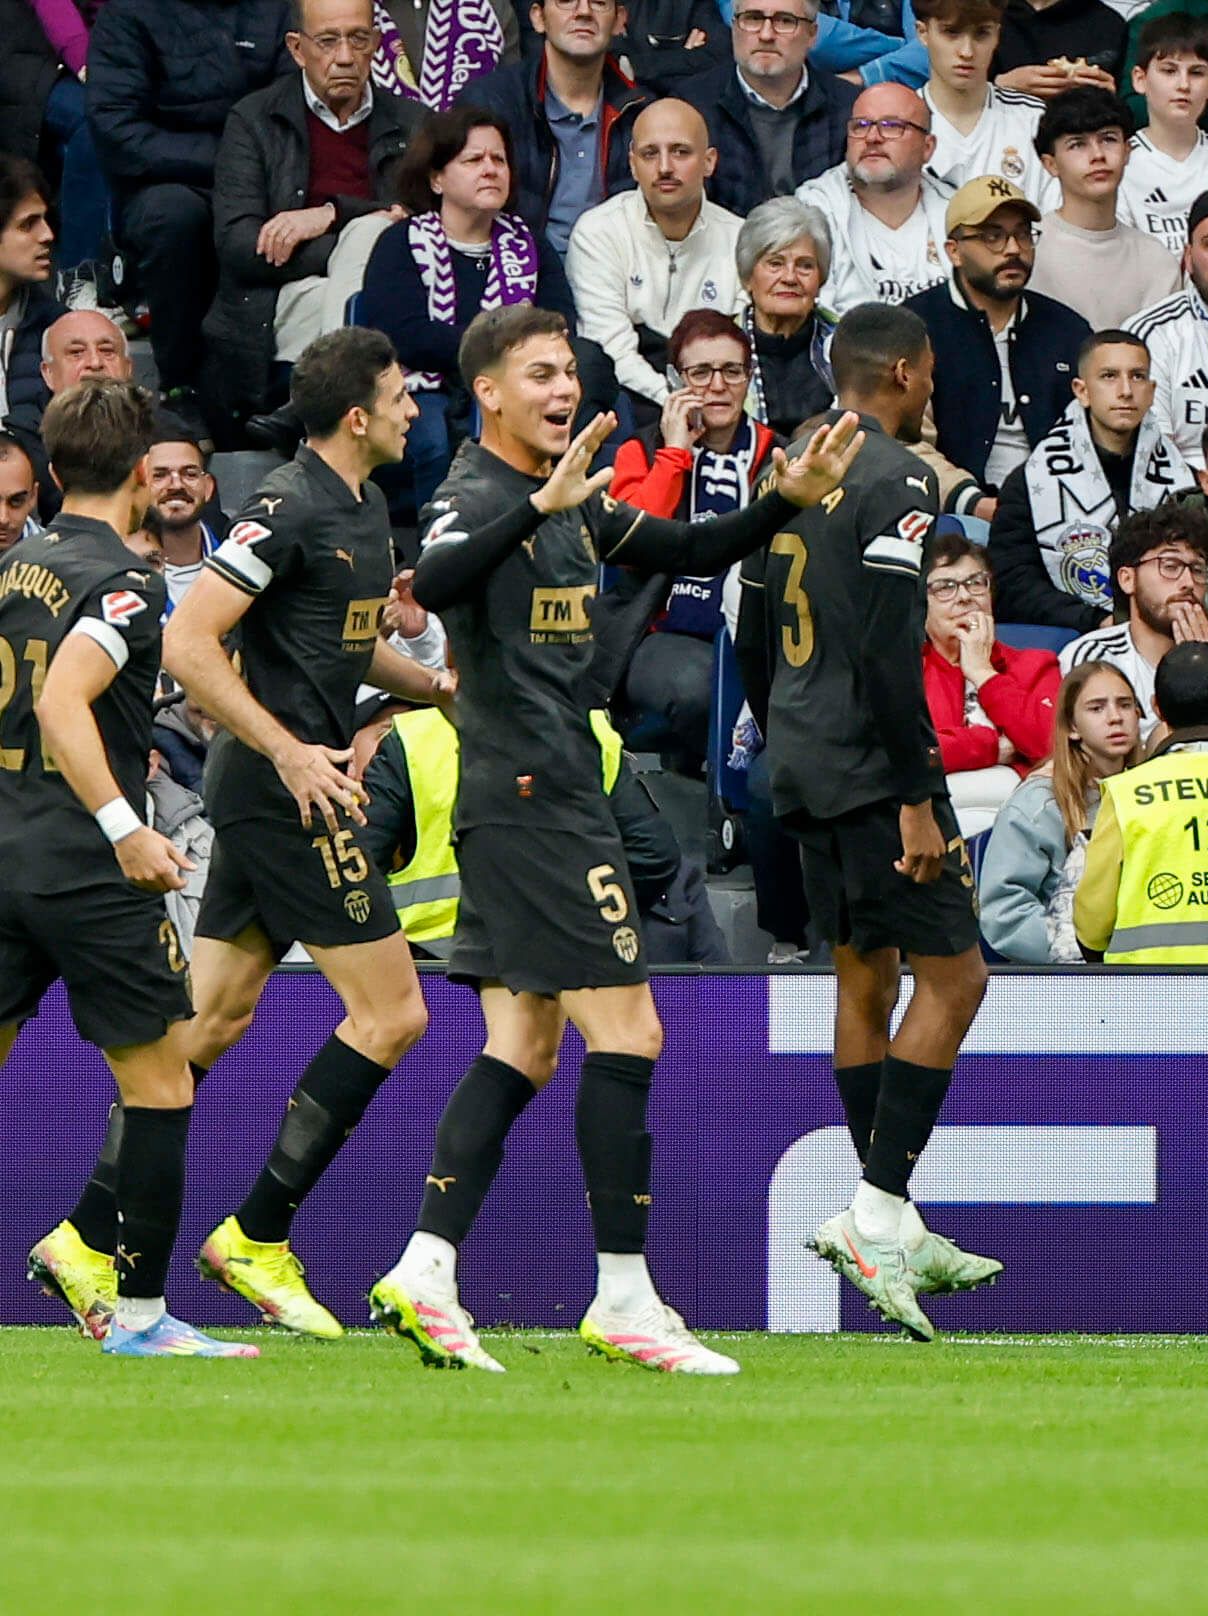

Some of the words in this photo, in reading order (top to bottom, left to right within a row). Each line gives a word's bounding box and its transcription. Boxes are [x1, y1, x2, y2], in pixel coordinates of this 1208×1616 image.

[540, 600, 571, 621] TM
[672, 583, 712, 600] RMCF
[769, 532, 814, 668] 3
[352, 611, 369, 631] TM
[312, 829, 369, 888] 15
[587, 863, 628, 923] 5
